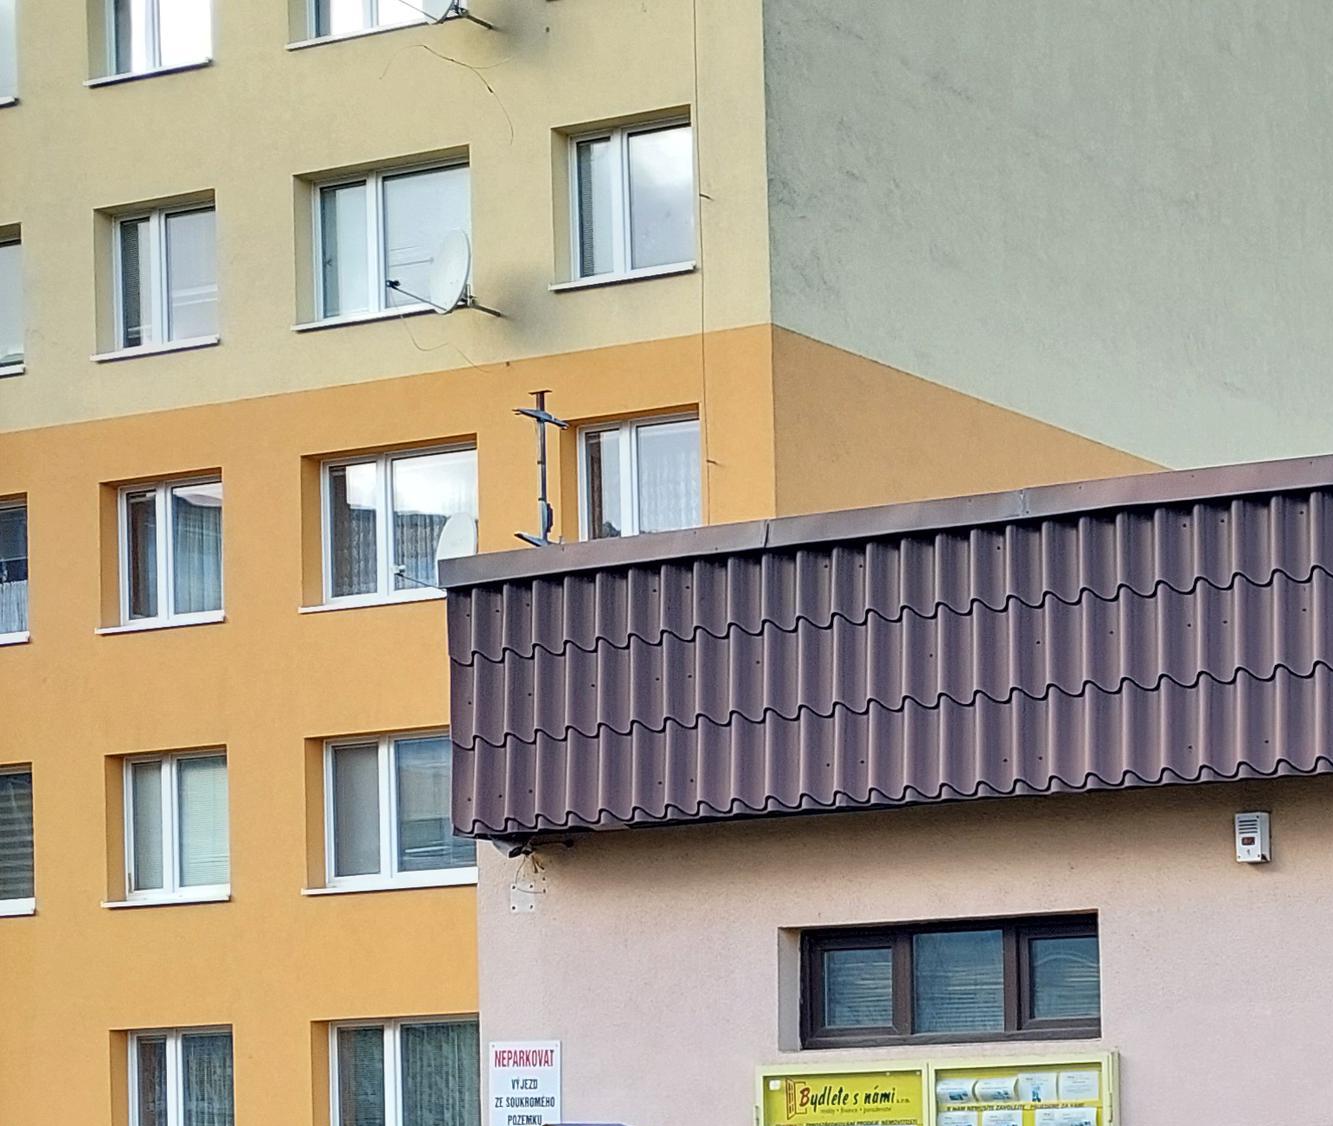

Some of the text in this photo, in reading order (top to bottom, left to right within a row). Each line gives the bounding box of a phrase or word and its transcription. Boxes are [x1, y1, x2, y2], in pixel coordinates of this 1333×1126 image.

[494, 1050, 554, 1067] NEPARKOVAT
[511, 1077, 538, 1089] VÝJEZD
[495, 1095, 555, 1108] ZE SOUKROMÉHO
[799, 1086, 848, 1113] Bydlete
[853, 1091, 859, 1105] s
[864, 1085, 896, 1104] námi
[508, 1115, 542, 1126] POZEMKU
